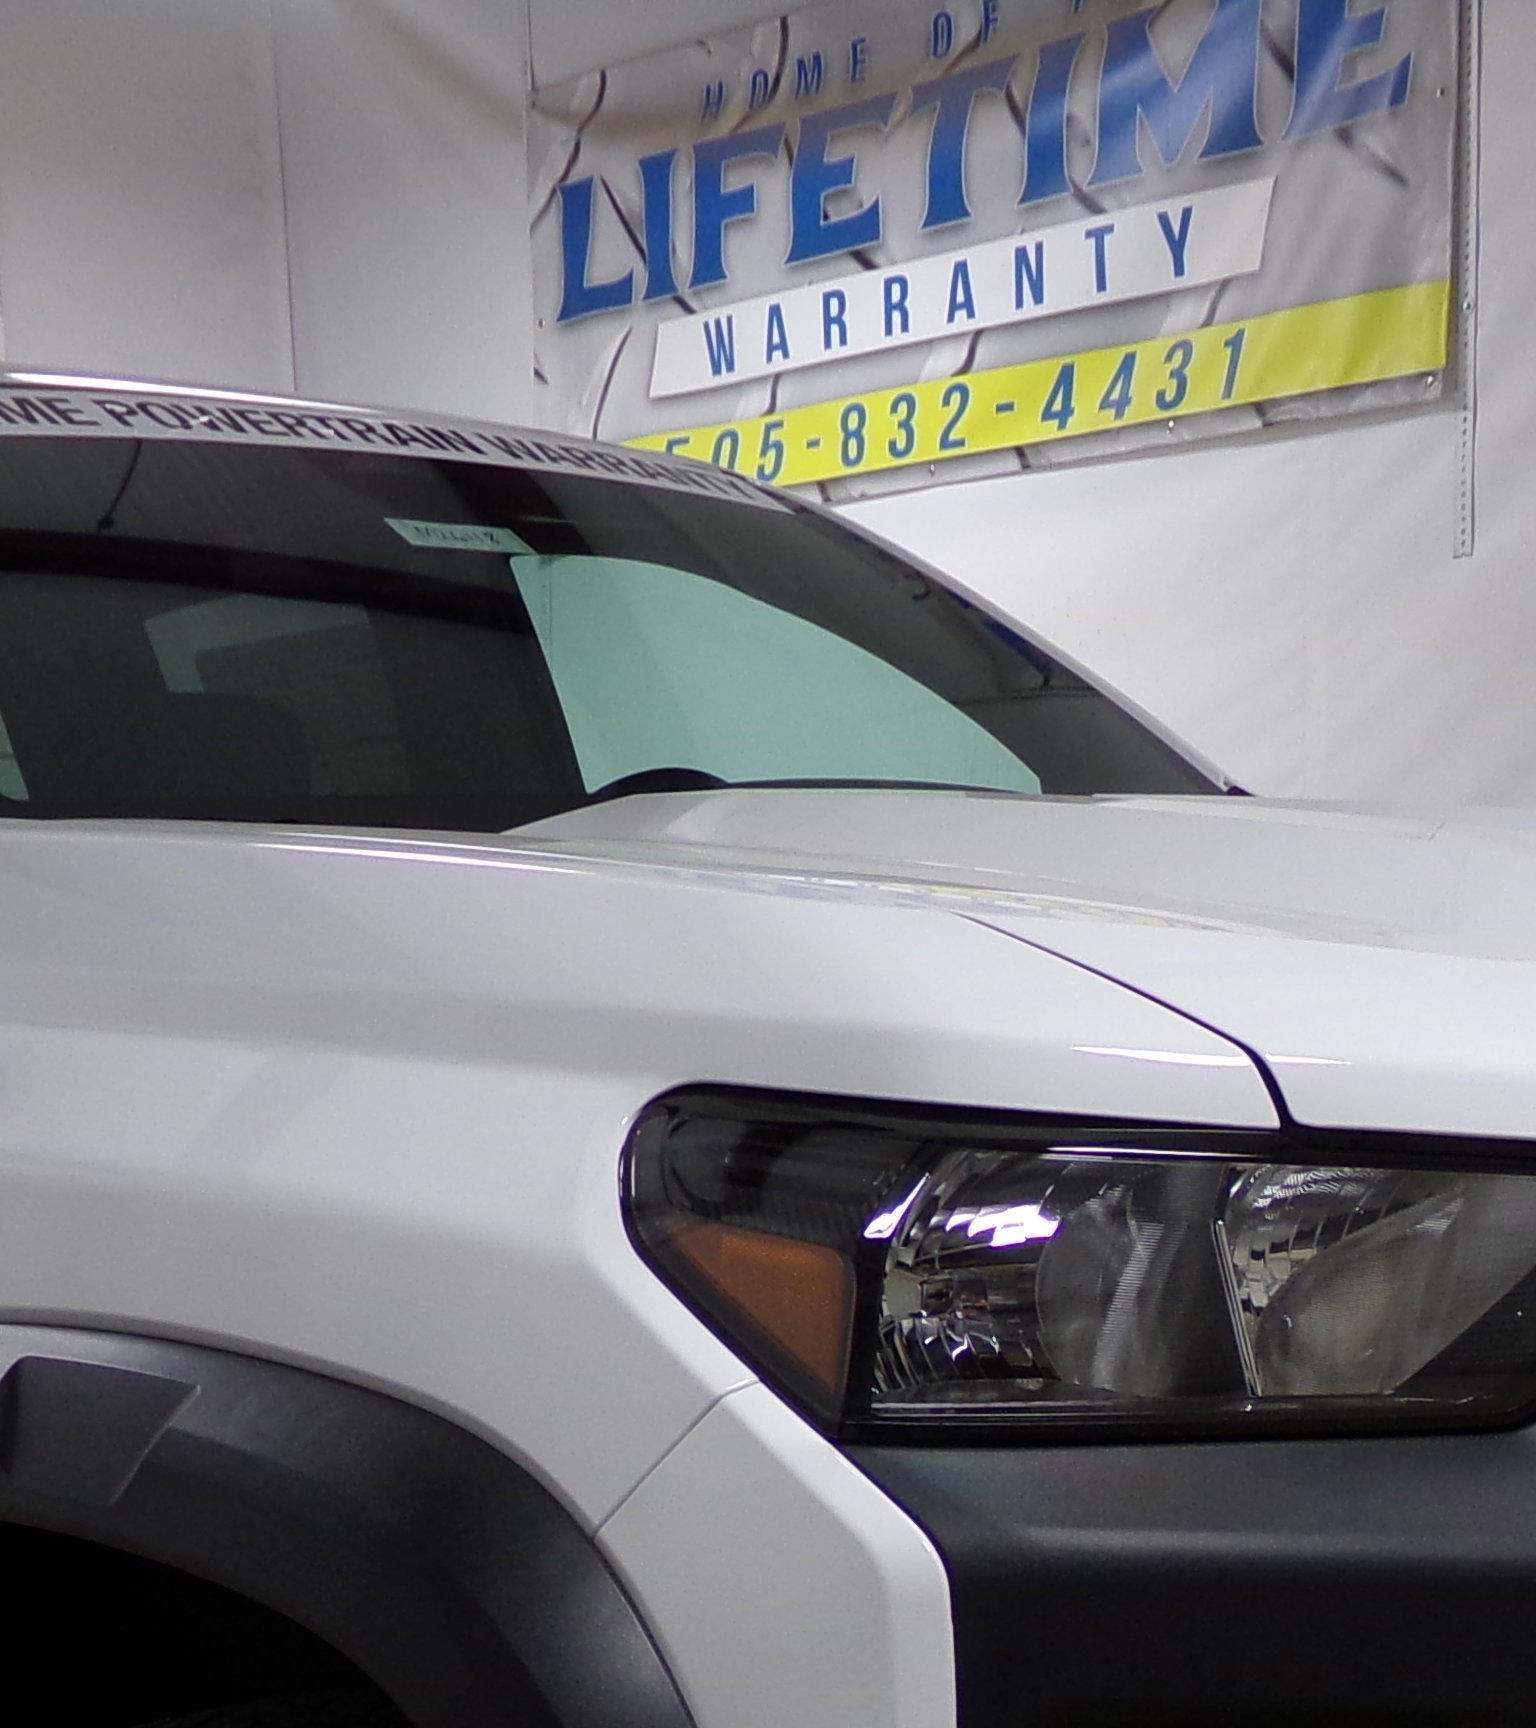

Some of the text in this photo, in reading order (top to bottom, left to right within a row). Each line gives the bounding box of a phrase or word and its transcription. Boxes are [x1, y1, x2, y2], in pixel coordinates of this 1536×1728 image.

[701, 0, 1000, 123] HOME OF
[556, 0, 1416, 323] LIFETIME
[702, 205, 1195, 377] WARRANTY
[92, 400, 487, 456] POWERTRAIN
[479, 432, 756, 500] WARRANTY
